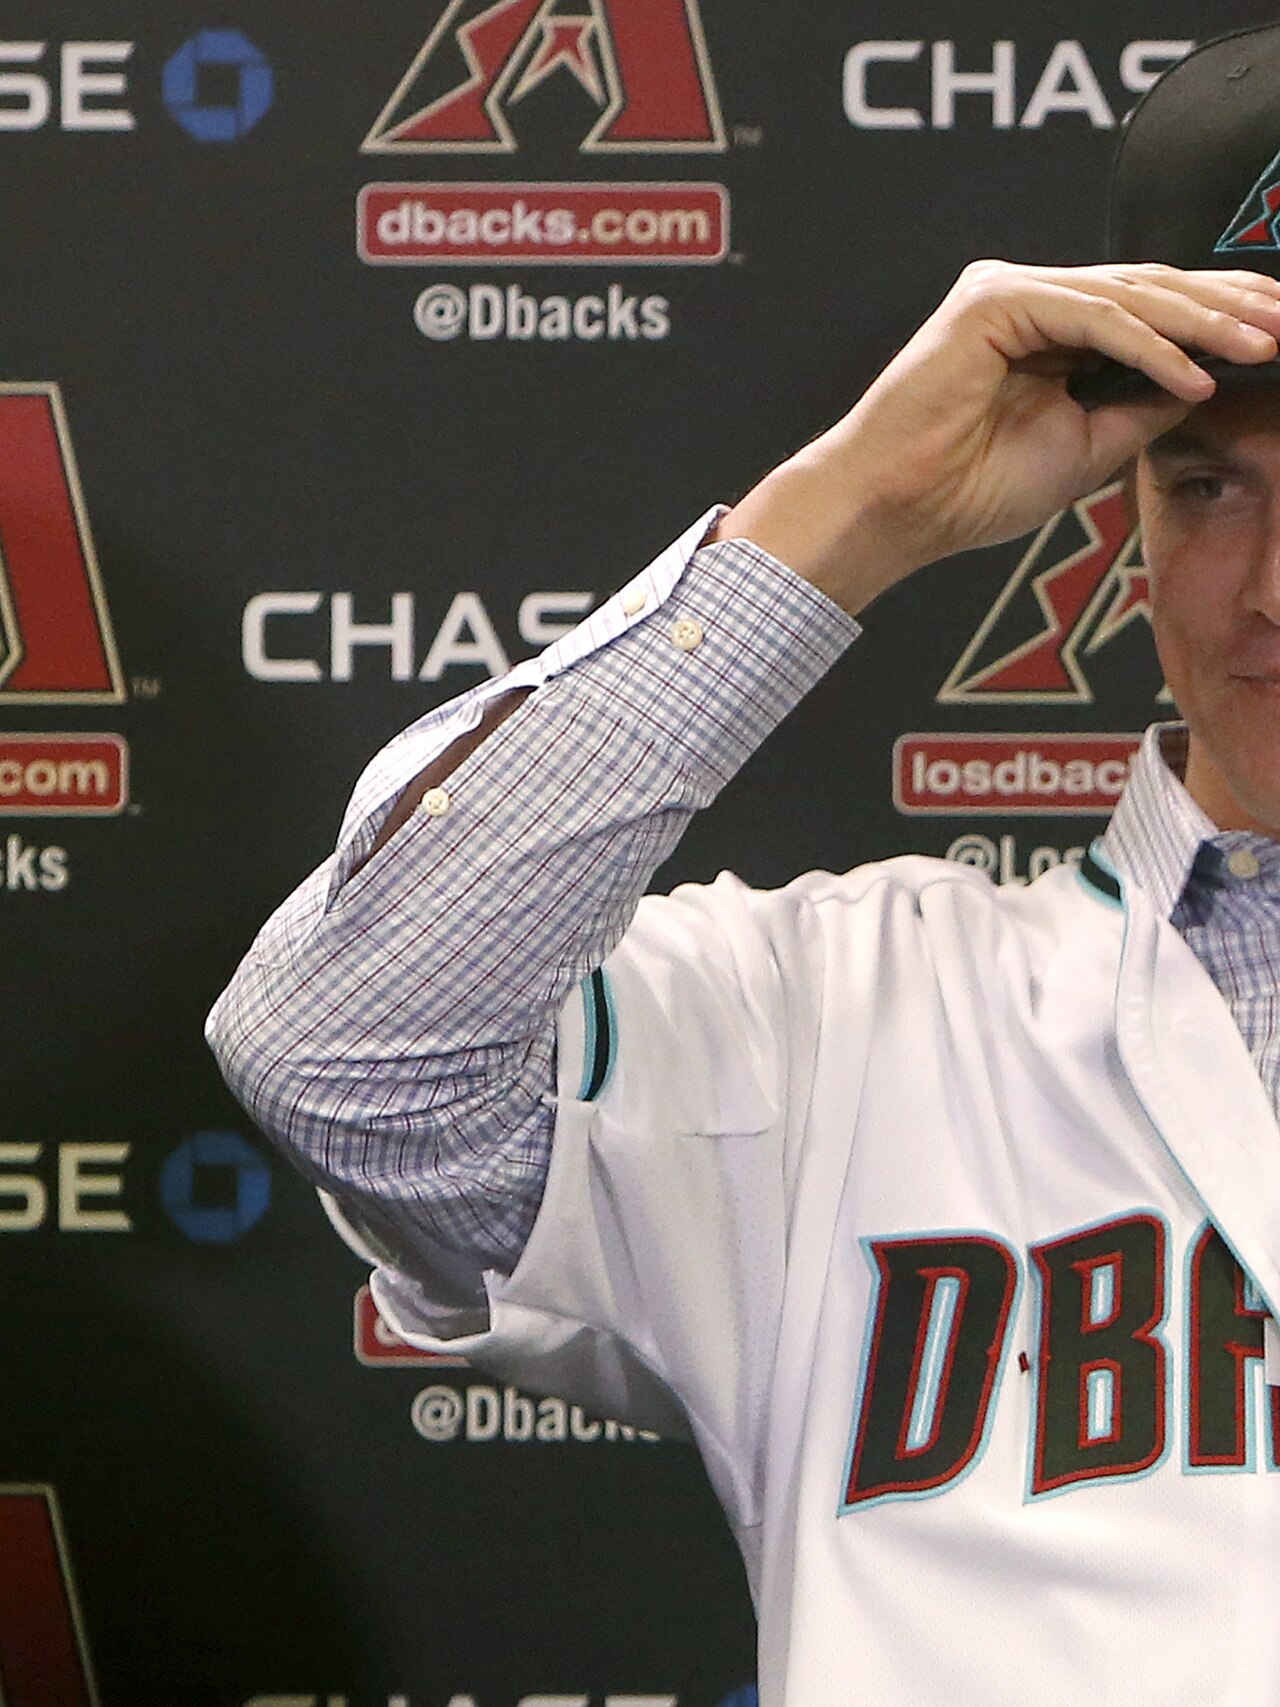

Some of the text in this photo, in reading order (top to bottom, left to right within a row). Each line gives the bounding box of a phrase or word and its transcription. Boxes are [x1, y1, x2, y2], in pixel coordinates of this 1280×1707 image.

[376, 202, 711, 245] dbacks.com
[413, 284, 671, 340] @Dbacks
[912, 751, 1138, 795] losdbac
